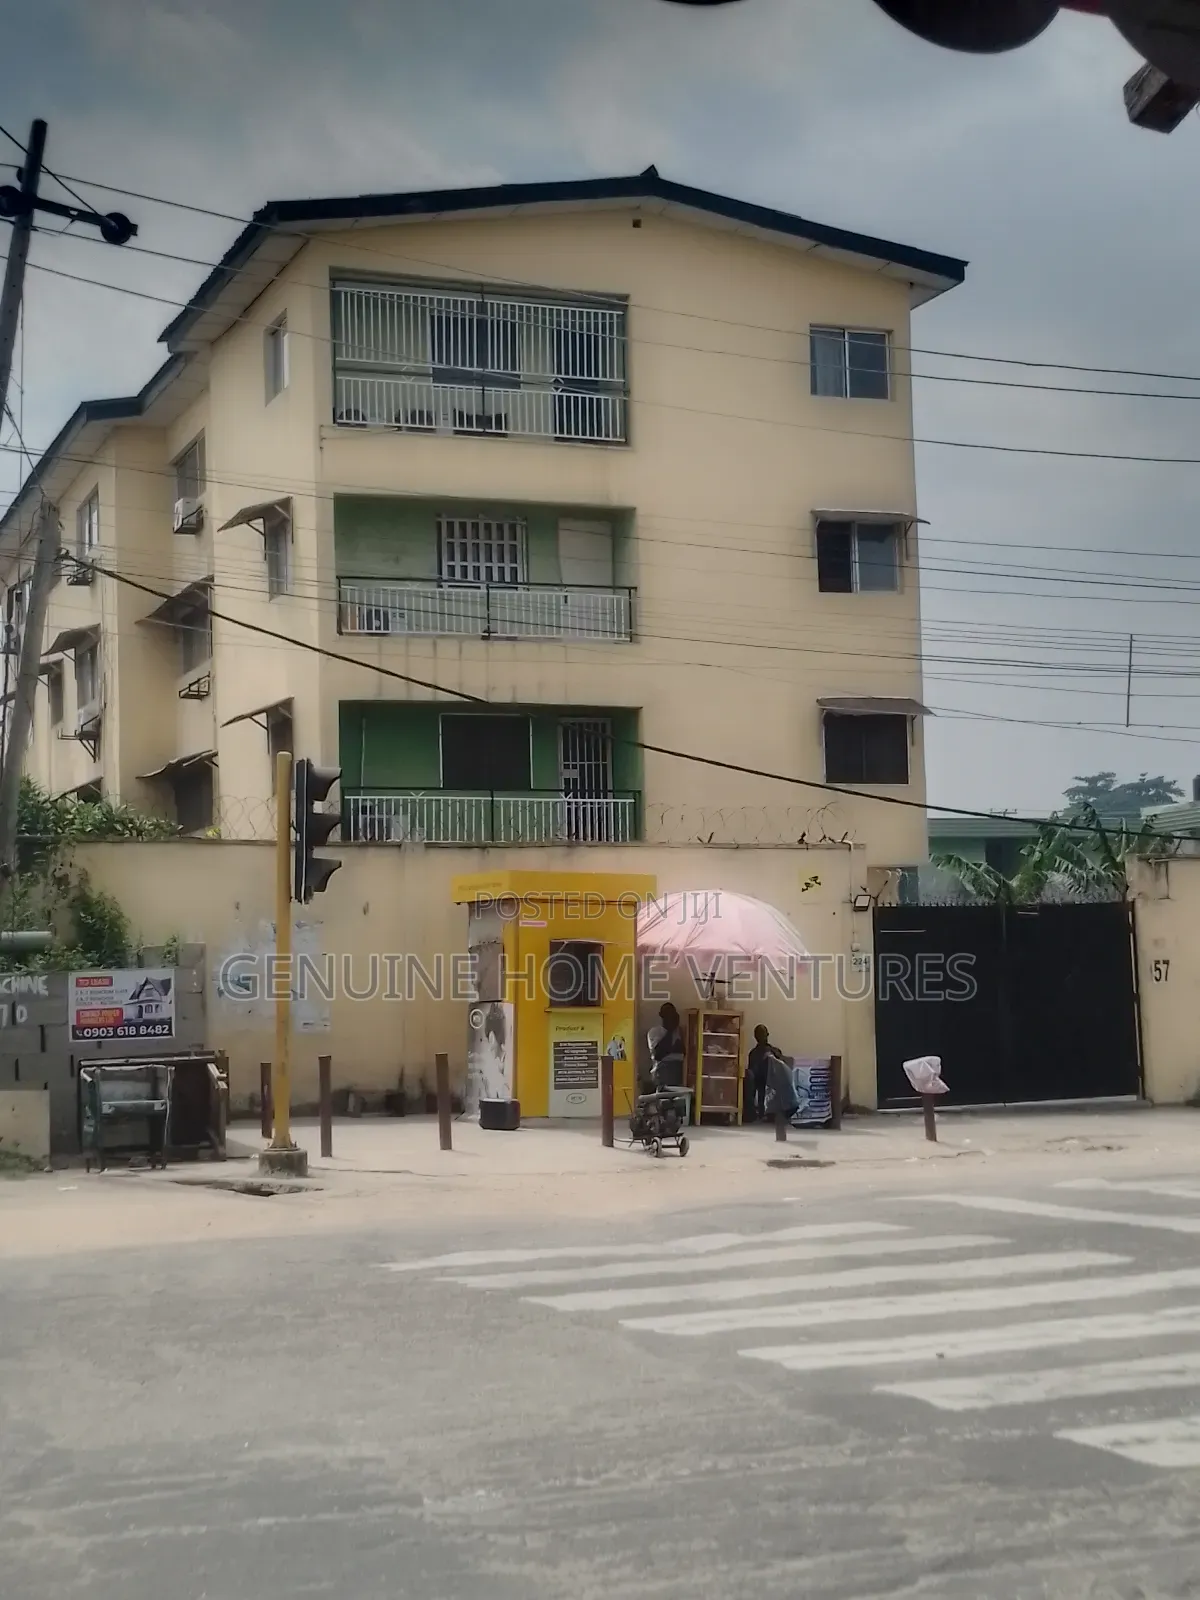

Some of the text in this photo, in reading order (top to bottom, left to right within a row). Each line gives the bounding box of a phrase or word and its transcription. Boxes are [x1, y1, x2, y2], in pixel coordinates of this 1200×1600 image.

[1154, 960, 1170, 982] 57
[83, 1025, 169, 1037] 0903 618 8482
